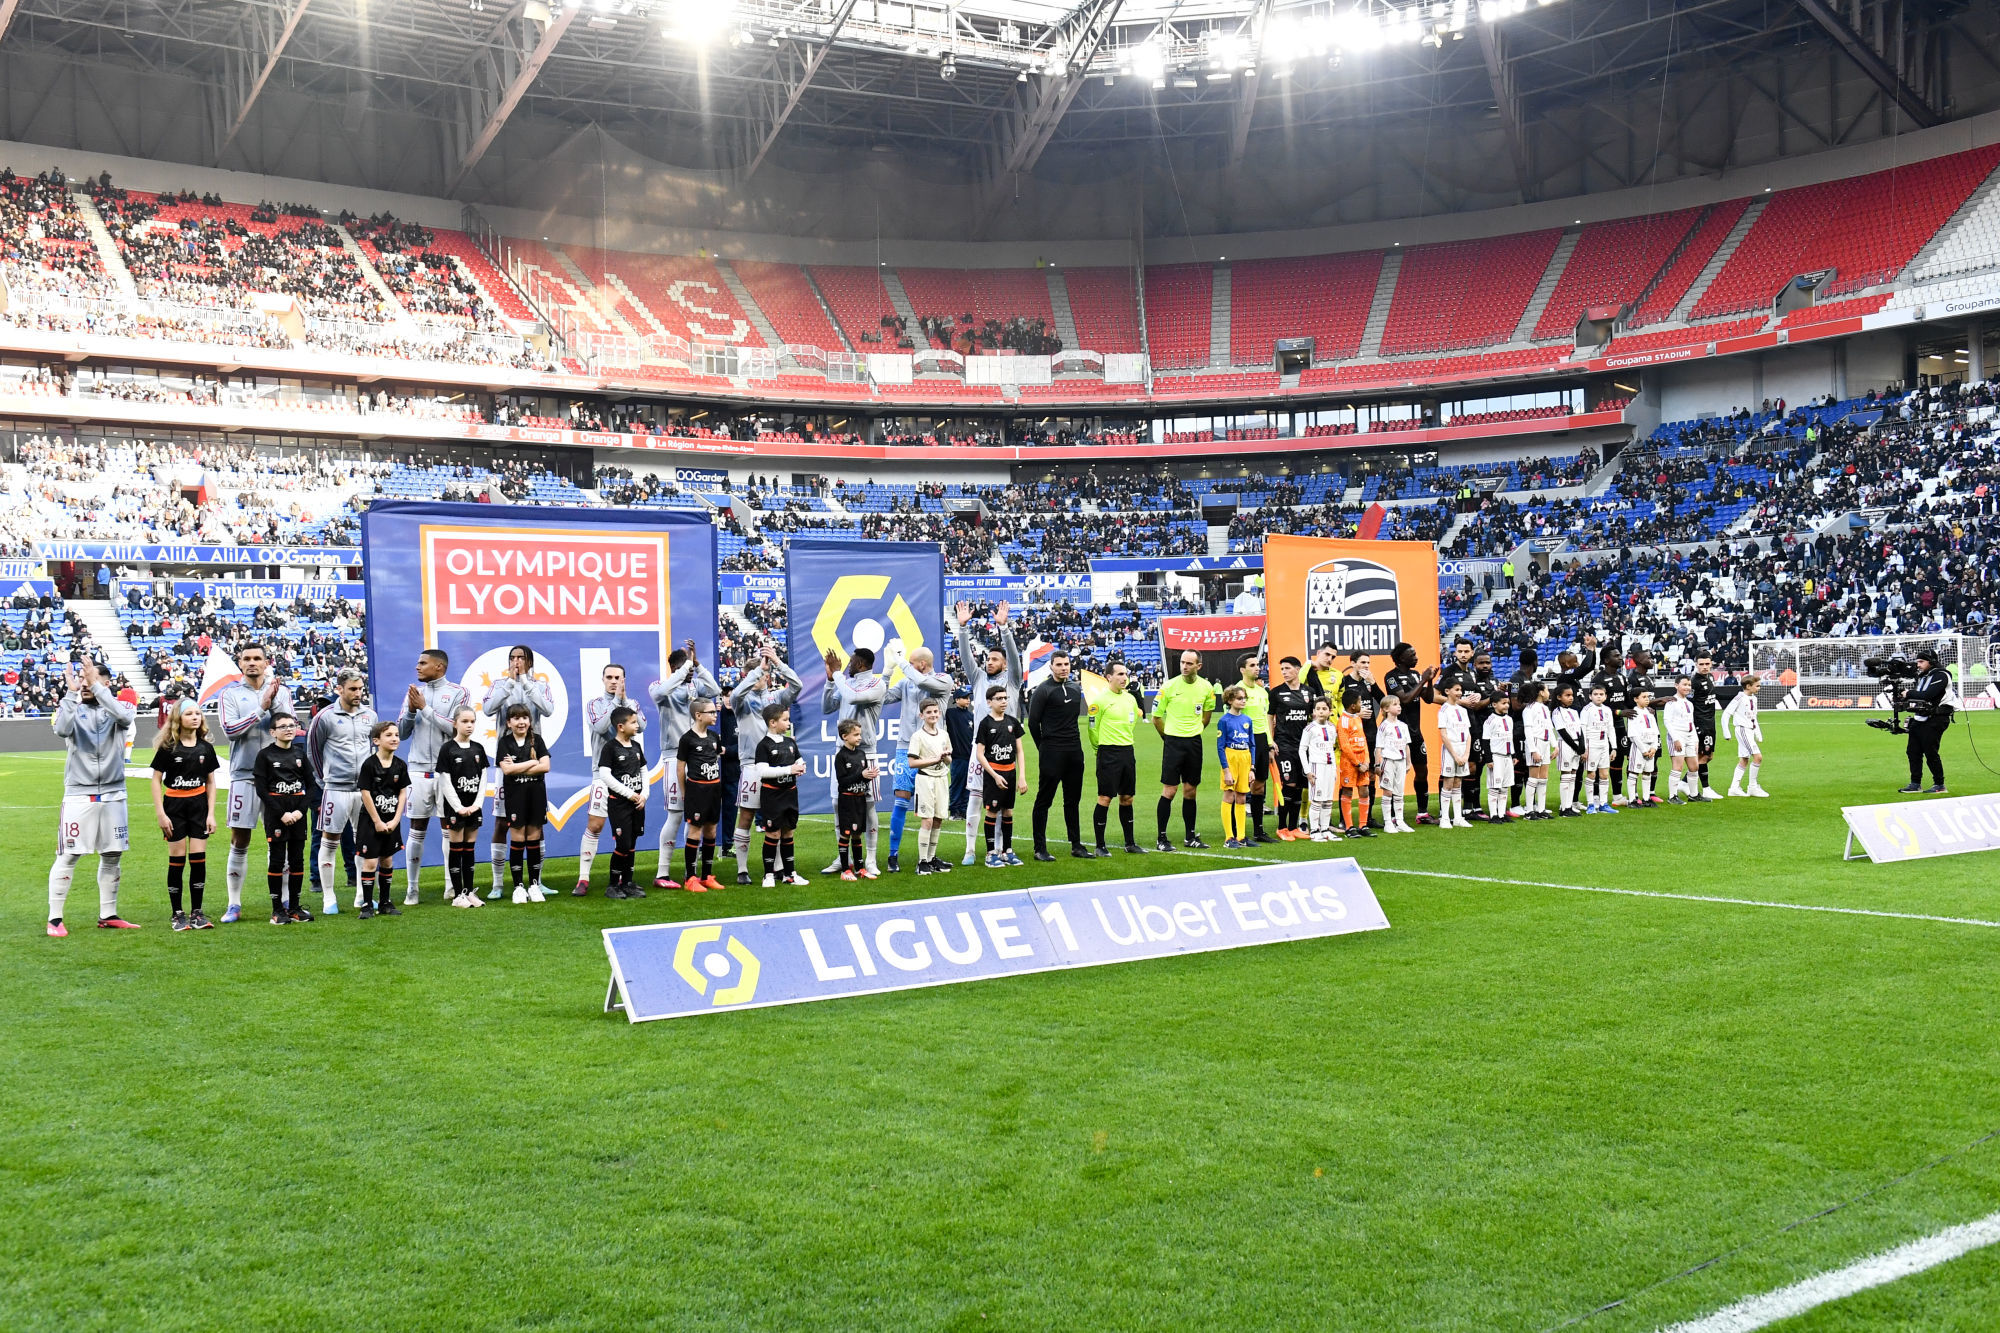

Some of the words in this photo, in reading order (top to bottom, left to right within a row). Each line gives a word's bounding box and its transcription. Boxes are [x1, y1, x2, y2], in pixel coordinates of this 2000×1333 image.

[1606, 354, 1653, 366] Groupama
[1655, 350, 1691, 360] STADIUM
[519, 428, 560, 441] Orange
[580, 432, 620, 446] Orange
[657, 439, 667, 448] La
[668, 440, 694, 450] Région
[258, 548, 341, 564] OOGarden
[0, 561, 35, 577] ETTER
[446, 548, 648, 582] OLYMPIQUE
[743, 574, 786, 588] Orange
[945, 578, 975, 587] Emirates
[204, 584, 276, 599] Emirates
[281, 584, 299, 599] FLY
[300, 585, 338, 599] BETTER
[449, 584, 648, 616] LYONNAIS
[1167, 626, 1260, 638] Emirates
[1180, 635, 1203, 643] FLY
[1203, 634, 1247, 644] BETTER
[1310, 624, 1330, 650] FC
[1335, 624, 1397, 650] LORIENT
[1807, 697, 1854, 708] Orange
[995, 752, 1011, 761] Cola
[968, 762, 983, 776] 88
[1281, 760, 1292, 773] 19
[669, 782, 678, 796] 4
[741, 780, 758, 795] 24
[234, 795, 244, 811] 5
[325, 801, 335, 816] 3
[64, 822, 80, 838] 18
[799, 906, 1035, 982] LIGUE
[1041, 901, 1080, 951] 1
[1091, 895, 1222, 946] Uber
[1220, 880, 1349, 932] Eats
